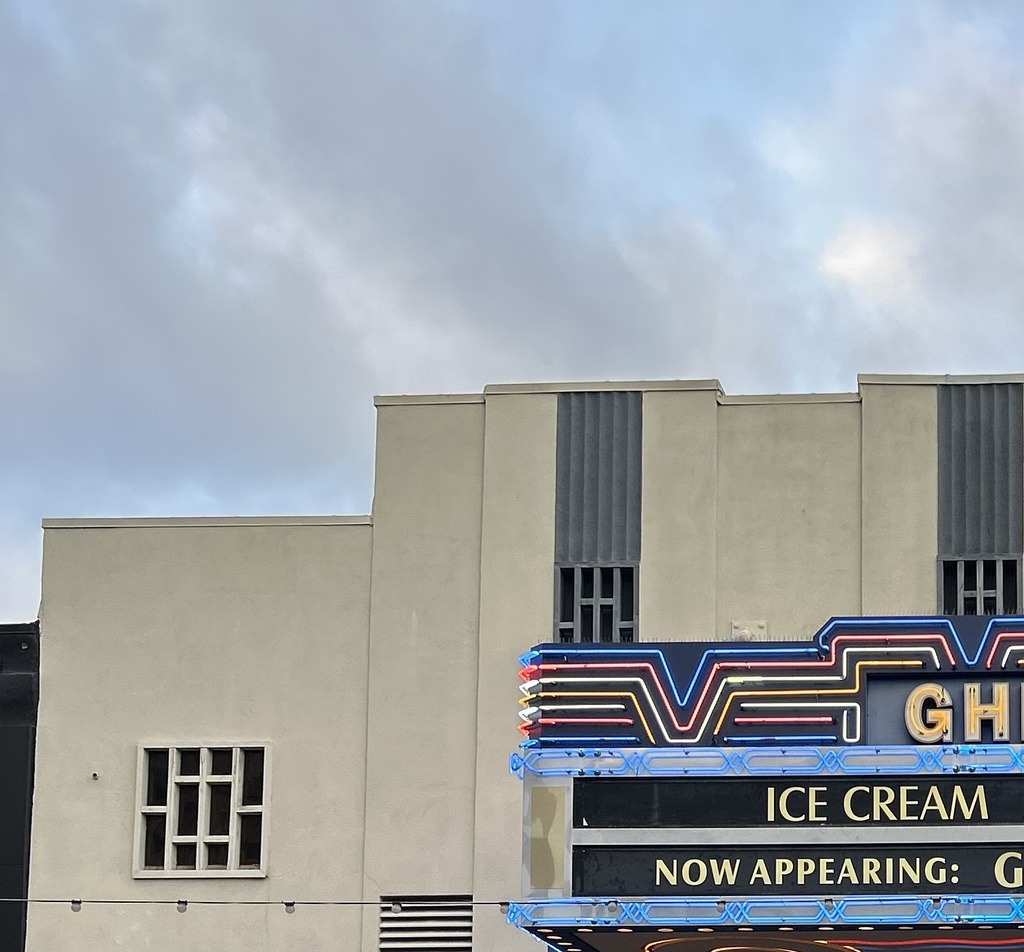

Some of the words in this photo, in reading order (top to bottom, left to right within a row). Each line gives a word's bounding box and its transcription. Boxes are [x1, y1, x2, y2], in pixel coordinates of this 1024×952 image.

[767, 787, 828, 822] ICE
[843, 785, 989, 822] CREAM
[655, 858, 741, 886] NOW
[749, 857, 960, 885] APPEARING:
